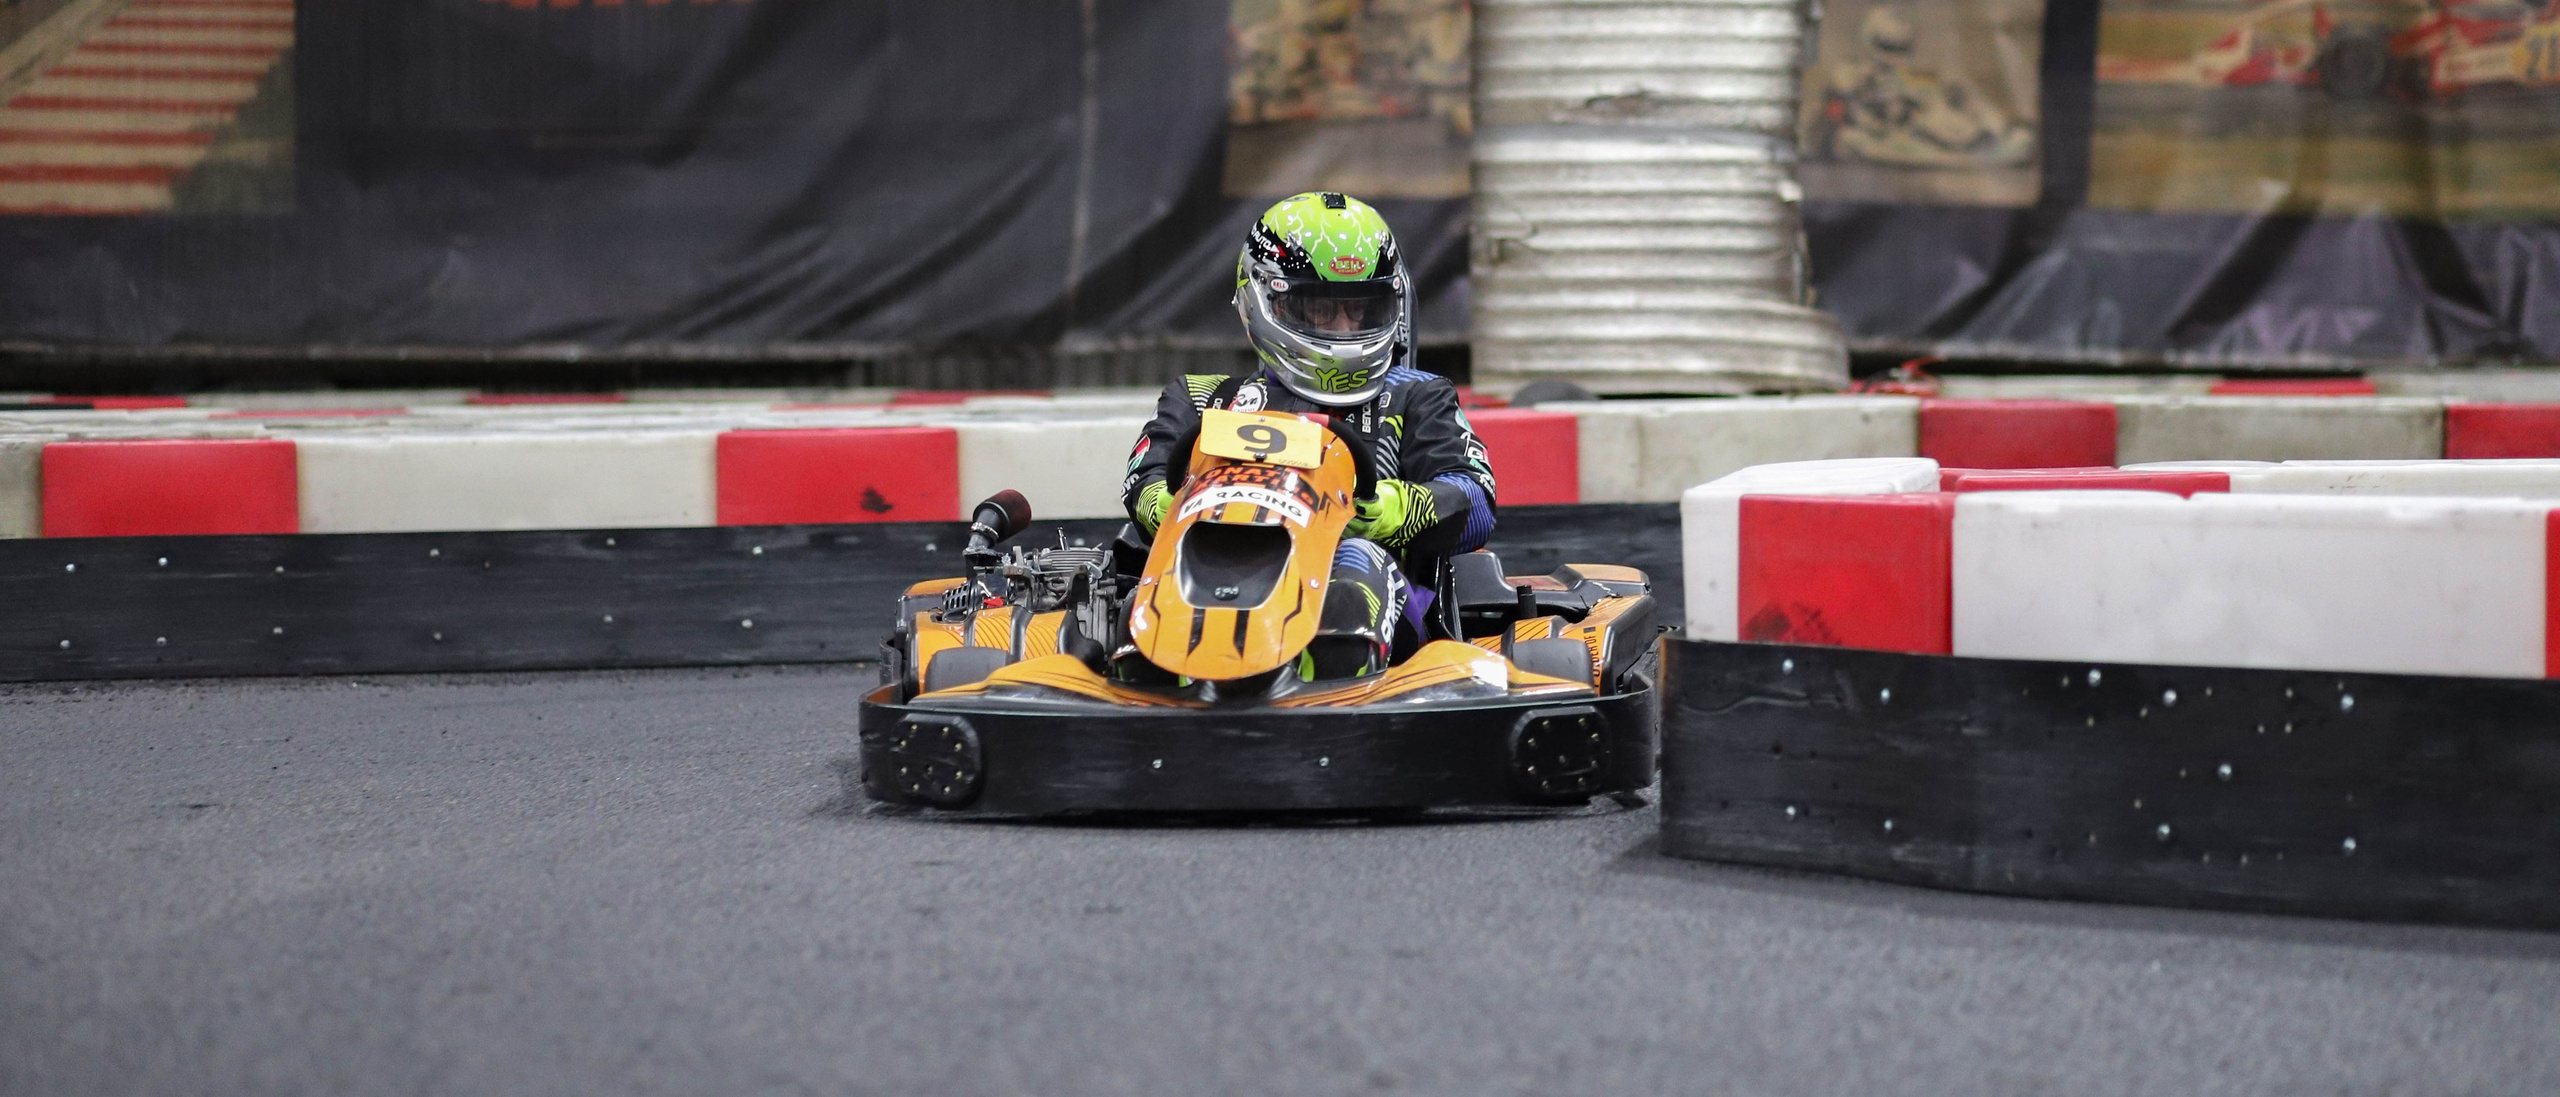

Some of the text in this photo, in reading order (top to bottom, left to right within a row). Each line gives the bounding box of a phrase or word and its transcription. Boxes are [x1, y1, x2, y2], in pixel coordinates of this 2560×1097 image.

[1336, 260, 1361, 270] BELL
[1315, 367, 1370, 393] YES
[1237, 425, 1287, 454] 9
